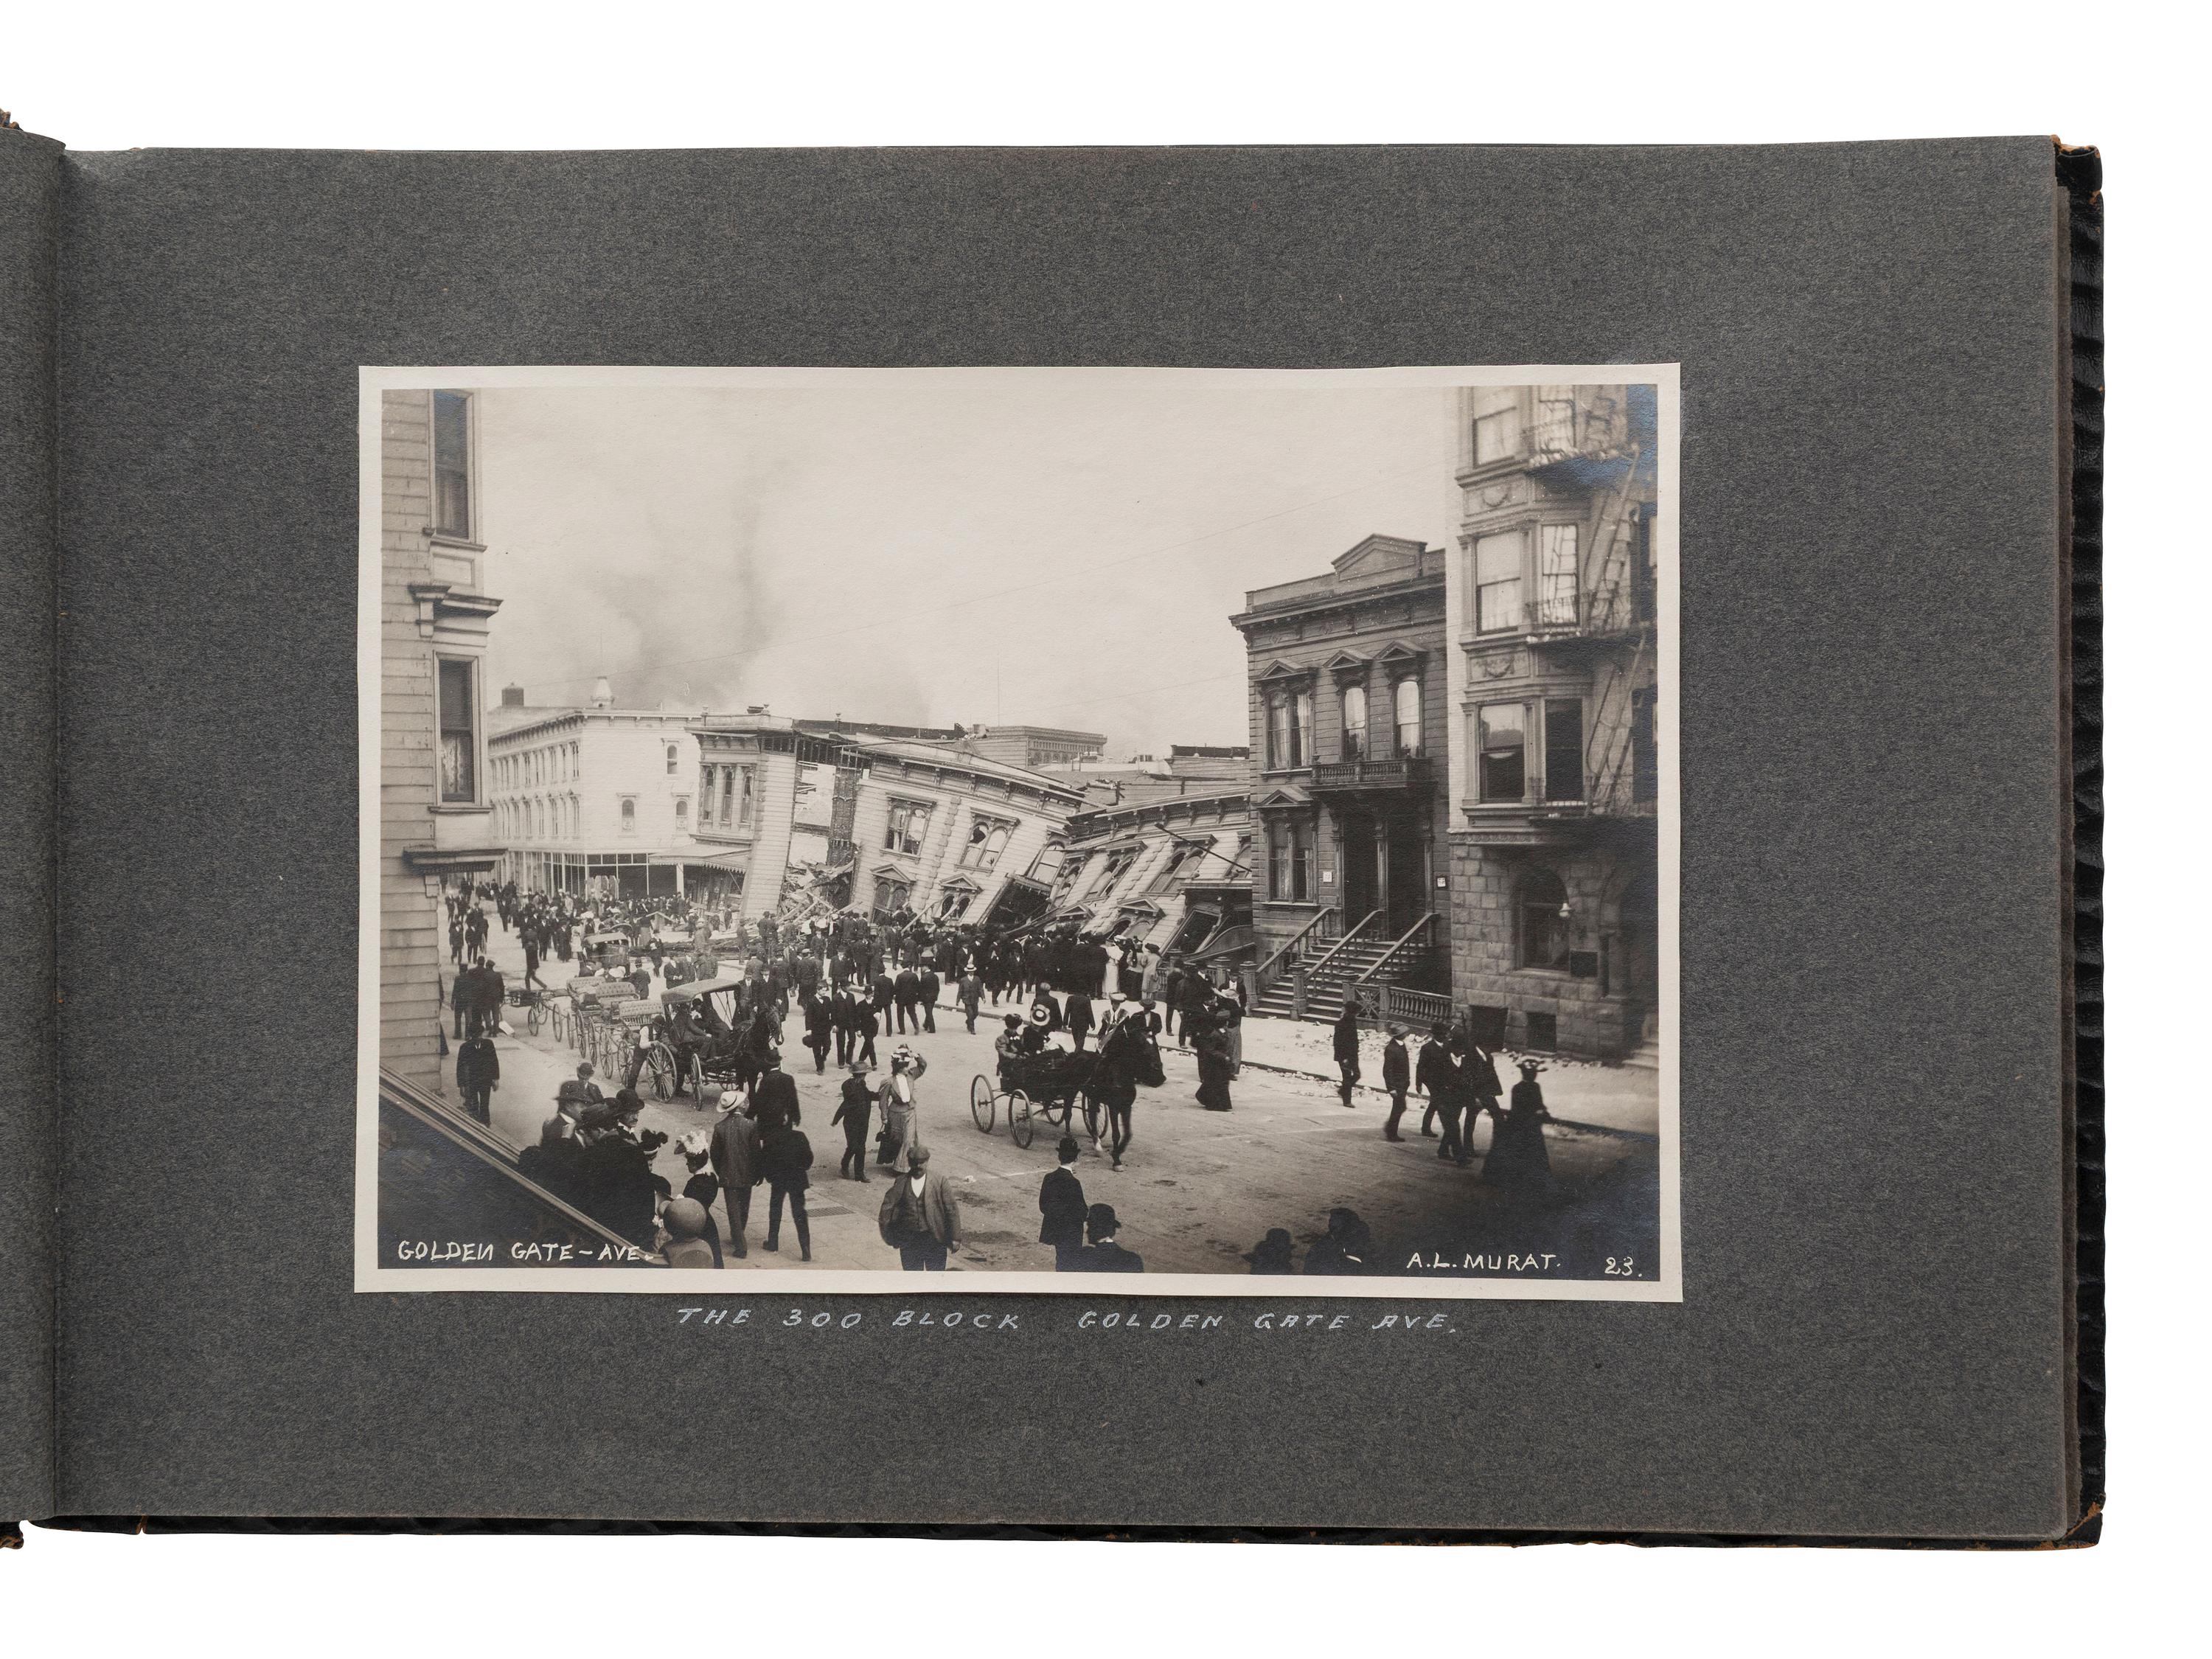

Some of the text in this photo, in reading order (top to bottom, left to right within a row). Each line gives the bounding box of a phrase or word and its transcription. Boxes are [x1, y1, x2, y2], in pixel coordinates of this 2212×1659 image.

[397, 1240, 494, 1262] GOLDEN
[1604, 1256, 1643, 1277] 23.
[677, 1308, 1456, 1333] THE 300 BLOCK GOLDEN GATE AVE.
